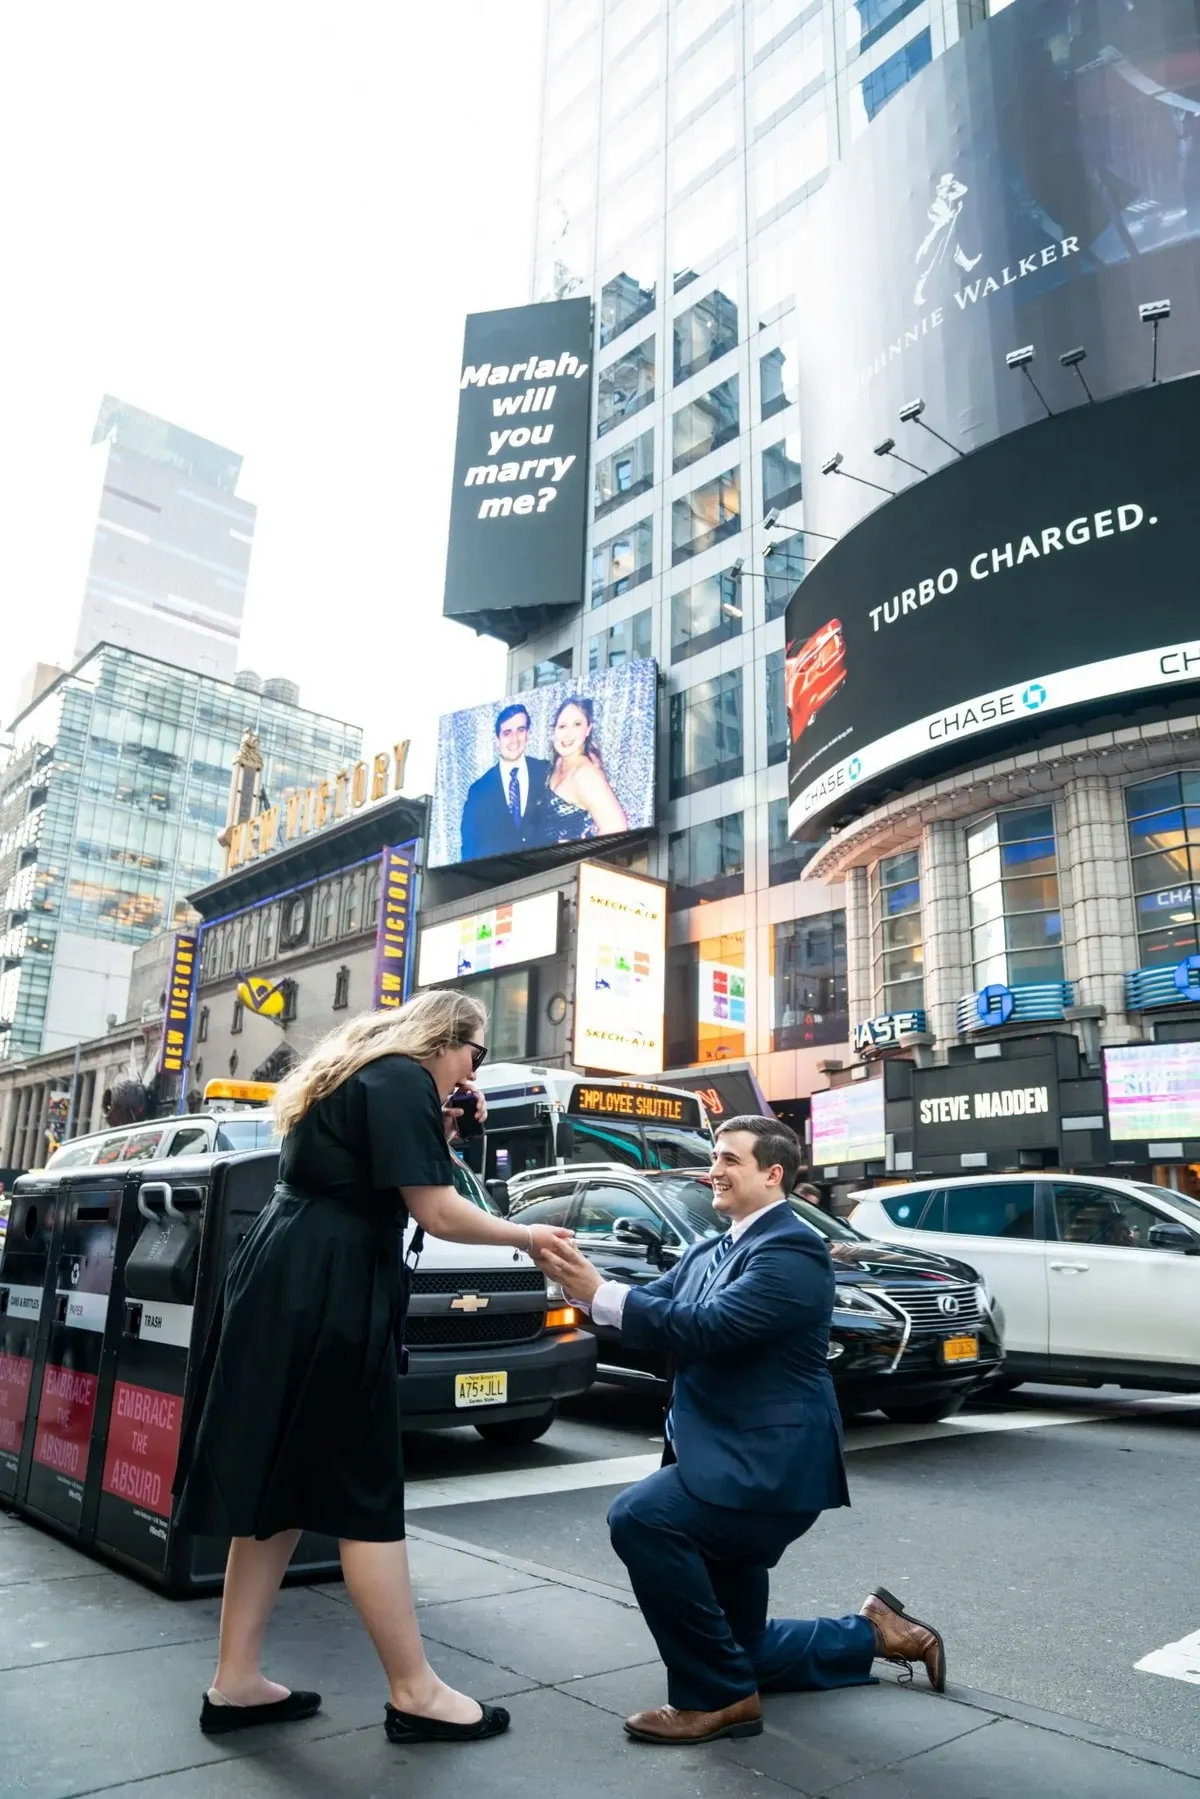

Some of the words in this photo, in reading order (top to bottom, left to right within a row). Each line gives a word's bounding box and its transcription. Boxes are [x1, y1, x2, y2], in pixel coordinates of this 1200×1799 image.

[953, 236, 1081, 310] WALKER
[461, 352, 588, 390] Mariah,
[492, 385, 556, 417] will
[487, 424, 554, 456] you
[464, 455, 576, 487] marry
[477, 487, 557, 520] me?
[869, 567, 959, 632] TURBO
[969, 503, 1159, 580] CHARGED.
[928, 693, 1016, 740] CHASE
[228, 805, 281, 869] NEW
[285, 739, 411, 841] VICTORY
[804, 768, 845, 810] CHASE
[383, 853, 409, 958] VICTORY
[589, 895, 659, 921] SKECH-AIR
[170, 939, 194, 1020] VICTORY
[378, 971, 402, 1014] EW
[164, 1029, 185, 1071] NEW
[585, 1028, 656, 1049] SKECH-AIR
[579, 1088, 633, 1114] EMPLOYEE
[635, 1095, 683, 1120] SHUTTLE
[919, 1094, 971, 1125] STEVE
[974, 1087, 1049, 1120] MADDEN
[144, 1314, 163, 1329] TRASH
[46, 1369, 93, 1407] EMBRACE
[460, 1382, 478, 1399] A75
[485, 1380, 503, 1396] JLL
[57, 1407, 71, 1428] THE
[116, 1388, 176, 1431] EMBRACE
[40, 1432, 80, 1473] ABSURD
[131, 1431, 149, 1456] THE
[110, 1459, 162, 1507] ABSURD
